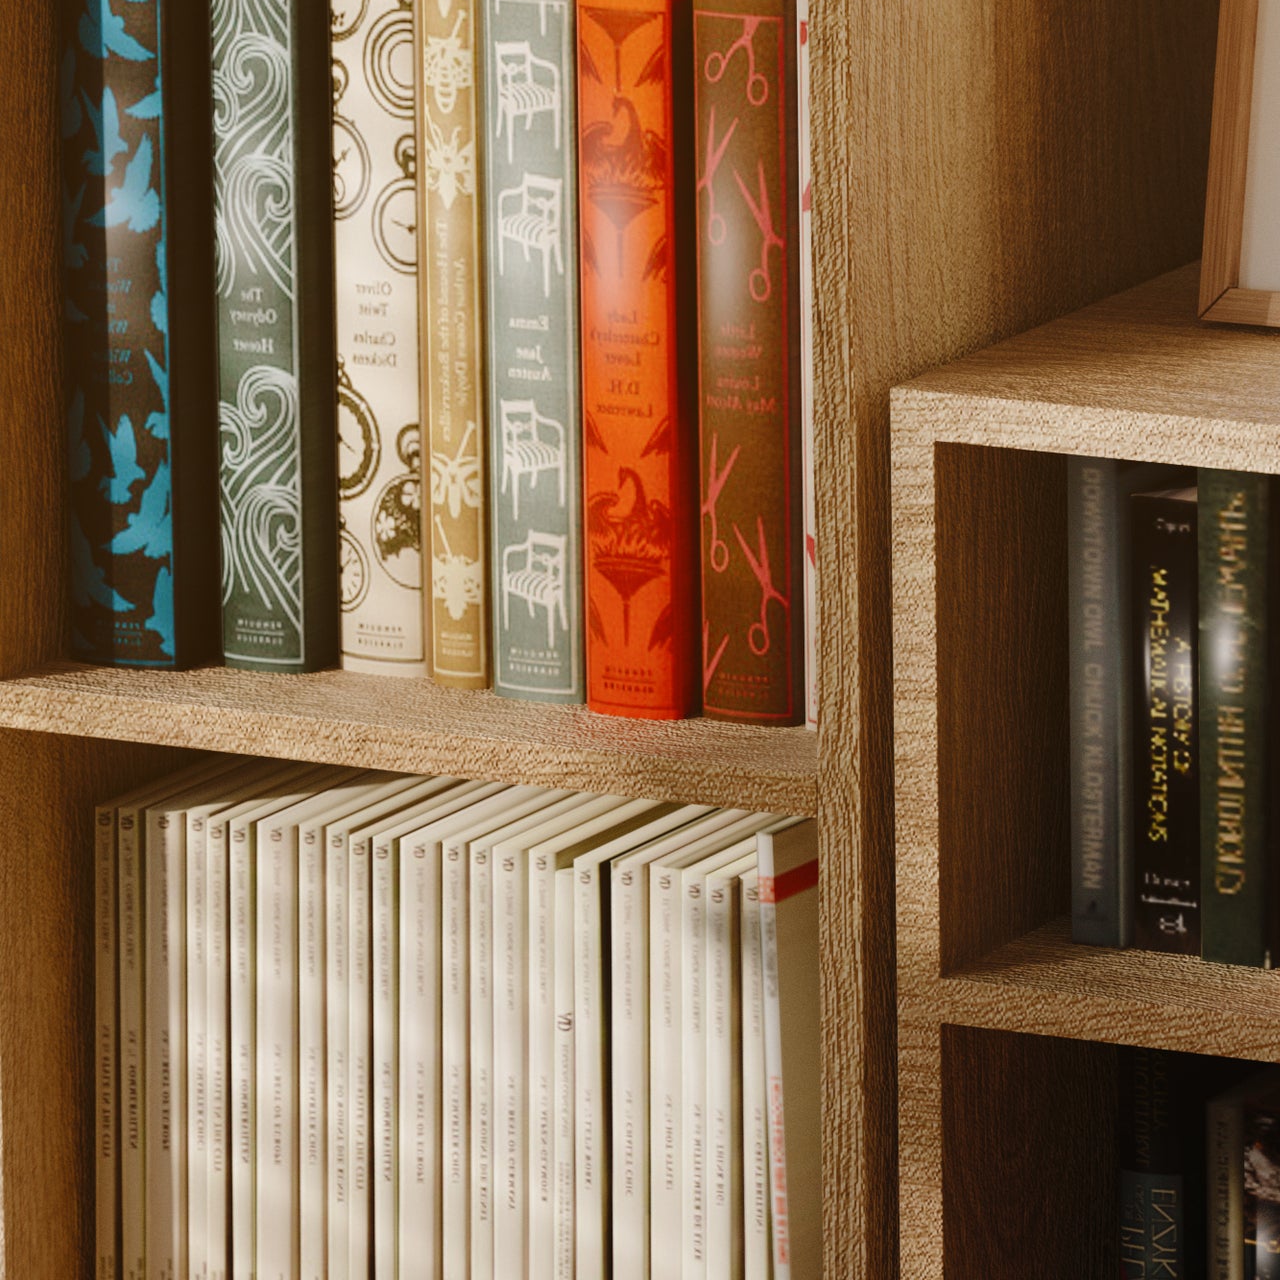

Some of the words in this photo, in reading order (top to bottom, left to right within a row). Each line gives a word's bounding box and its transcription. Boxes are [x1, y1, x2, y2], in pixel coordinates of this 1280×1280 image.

[1082, 468, 1103, 598] DOWNTOWN
[1082, 604, 1104, 651] OWL
[1083, 664, 1104, 737] CHUCK
[1082, 745, 1104, 889] KLOSTERMAN
